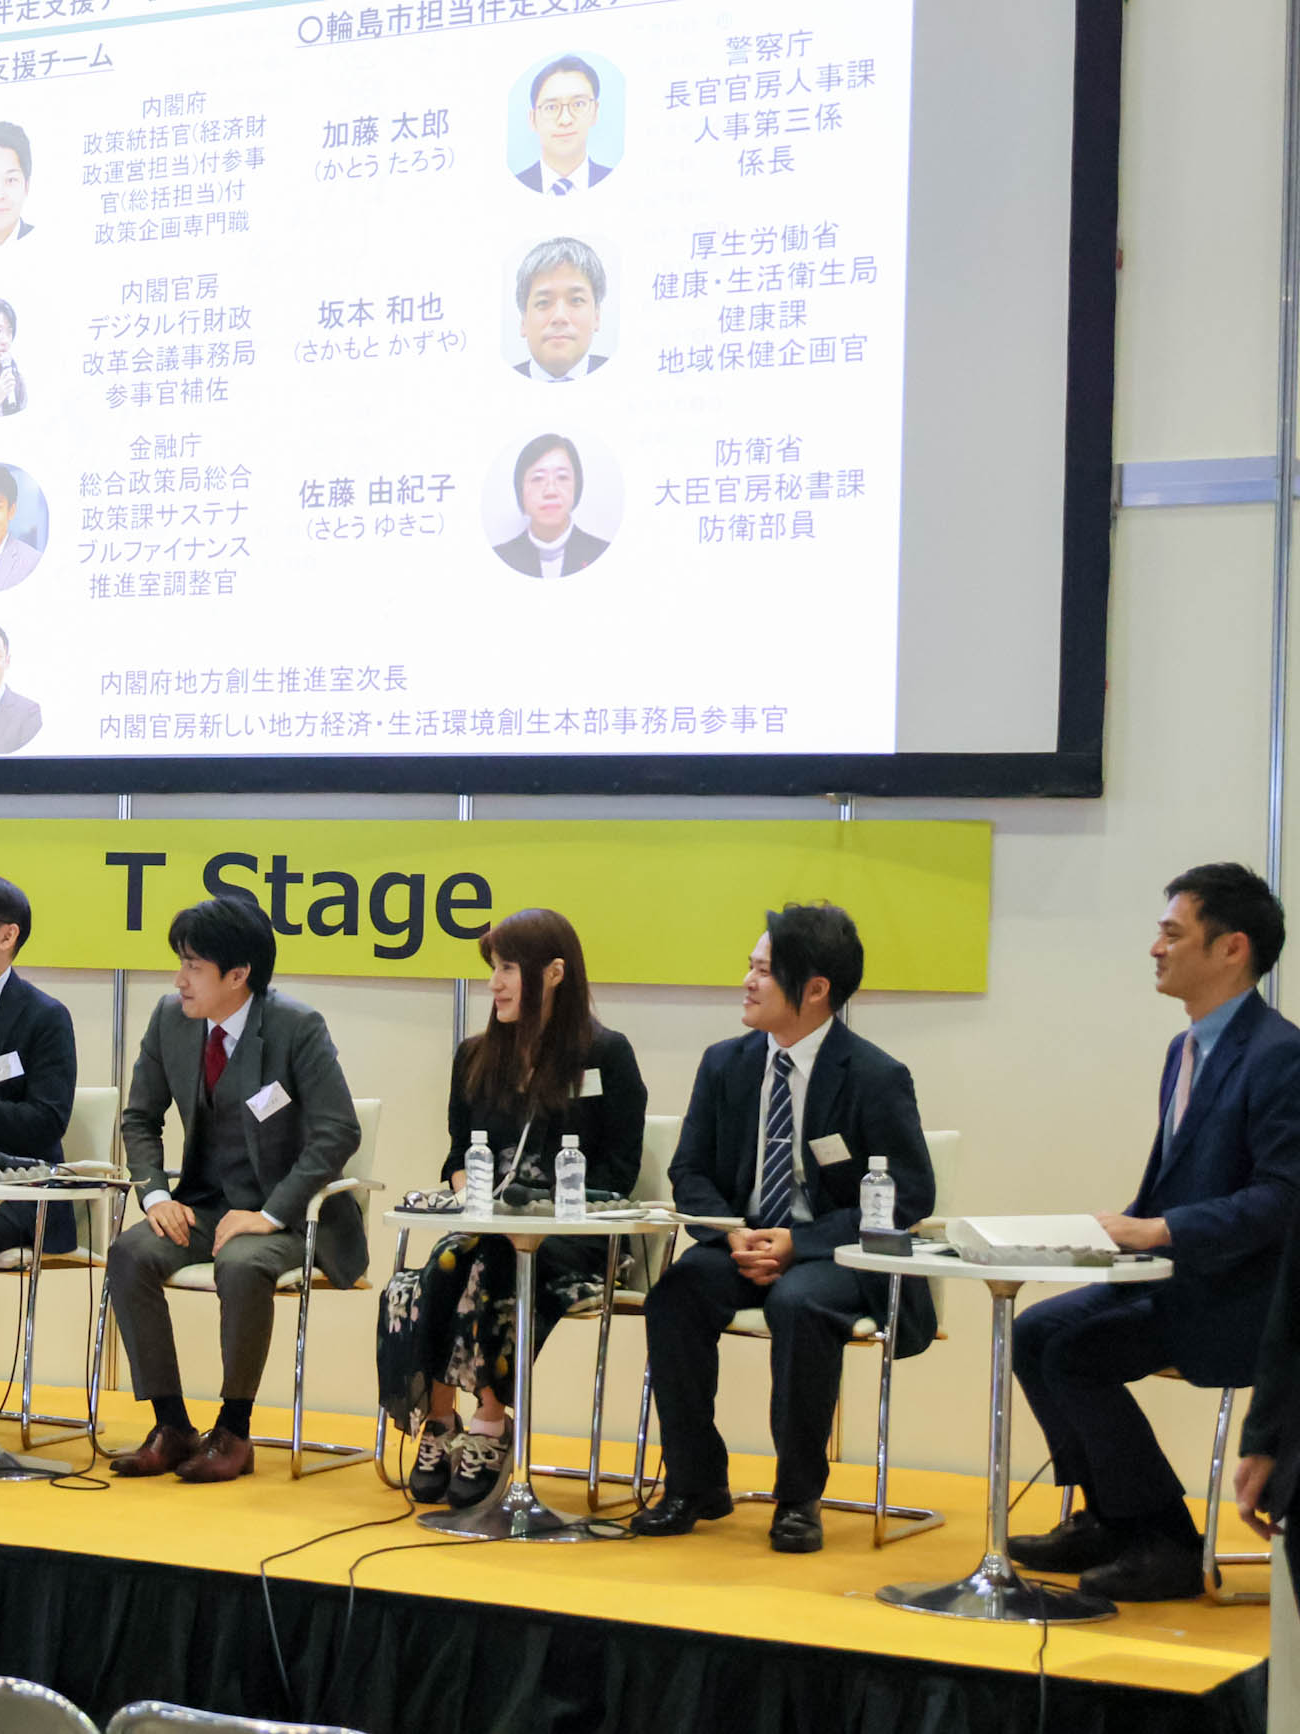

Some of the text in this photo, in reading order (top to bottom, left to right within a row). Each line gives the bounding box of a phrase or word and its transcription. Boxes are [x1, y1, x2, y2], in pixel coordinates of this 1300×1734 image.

[726, 29, 813, 66] 警察庁
[665, 59, 876, 109] 長官官房人事課
[143, 91, 207, 119] 内閣府
[322, 109, 449, 148] 加藤 太郎
[694, 102, 842, 143] 人事第三係
[738, 145, 795, 176] 係長
[95, 210, 250, 245] 政策企画専門職
[691, 221, 839, 260] 厚生労働省
[122, 273, 219, 304] 内閣官房
[88, 306, 251, 341] デジタル行財政
[318, 292, 444, 329] 坂本 和也
[718, 300, 807, 334] 健康課
[83, 340, 255, 376] 改革会議事務局
[657, 333, 868, 374] 地域保健企画官
[106, 376, 228, 409] 参事官補佐
[129, 433, 202, 460] 金融庁
[716, 434, 803, 467] 防衛省
[80, 464, 252, 496] 総合政策局総合
[299, 474, 455, 509] 佐藤 由紀子
[655, 469, 865, 506] 大臣官房秘書課
[81, 501, 248, 531] 政策課サステナ
[699, 510, 816, 544] 防衛部員
[78, 536, 250, 563] ブルファイナンス
[89, 568, 236, 599] 推進室調整官
[101, 665, 405, 696] 内閣府地方創生推進室次長
[105, 851, 493, 960] T Stage
